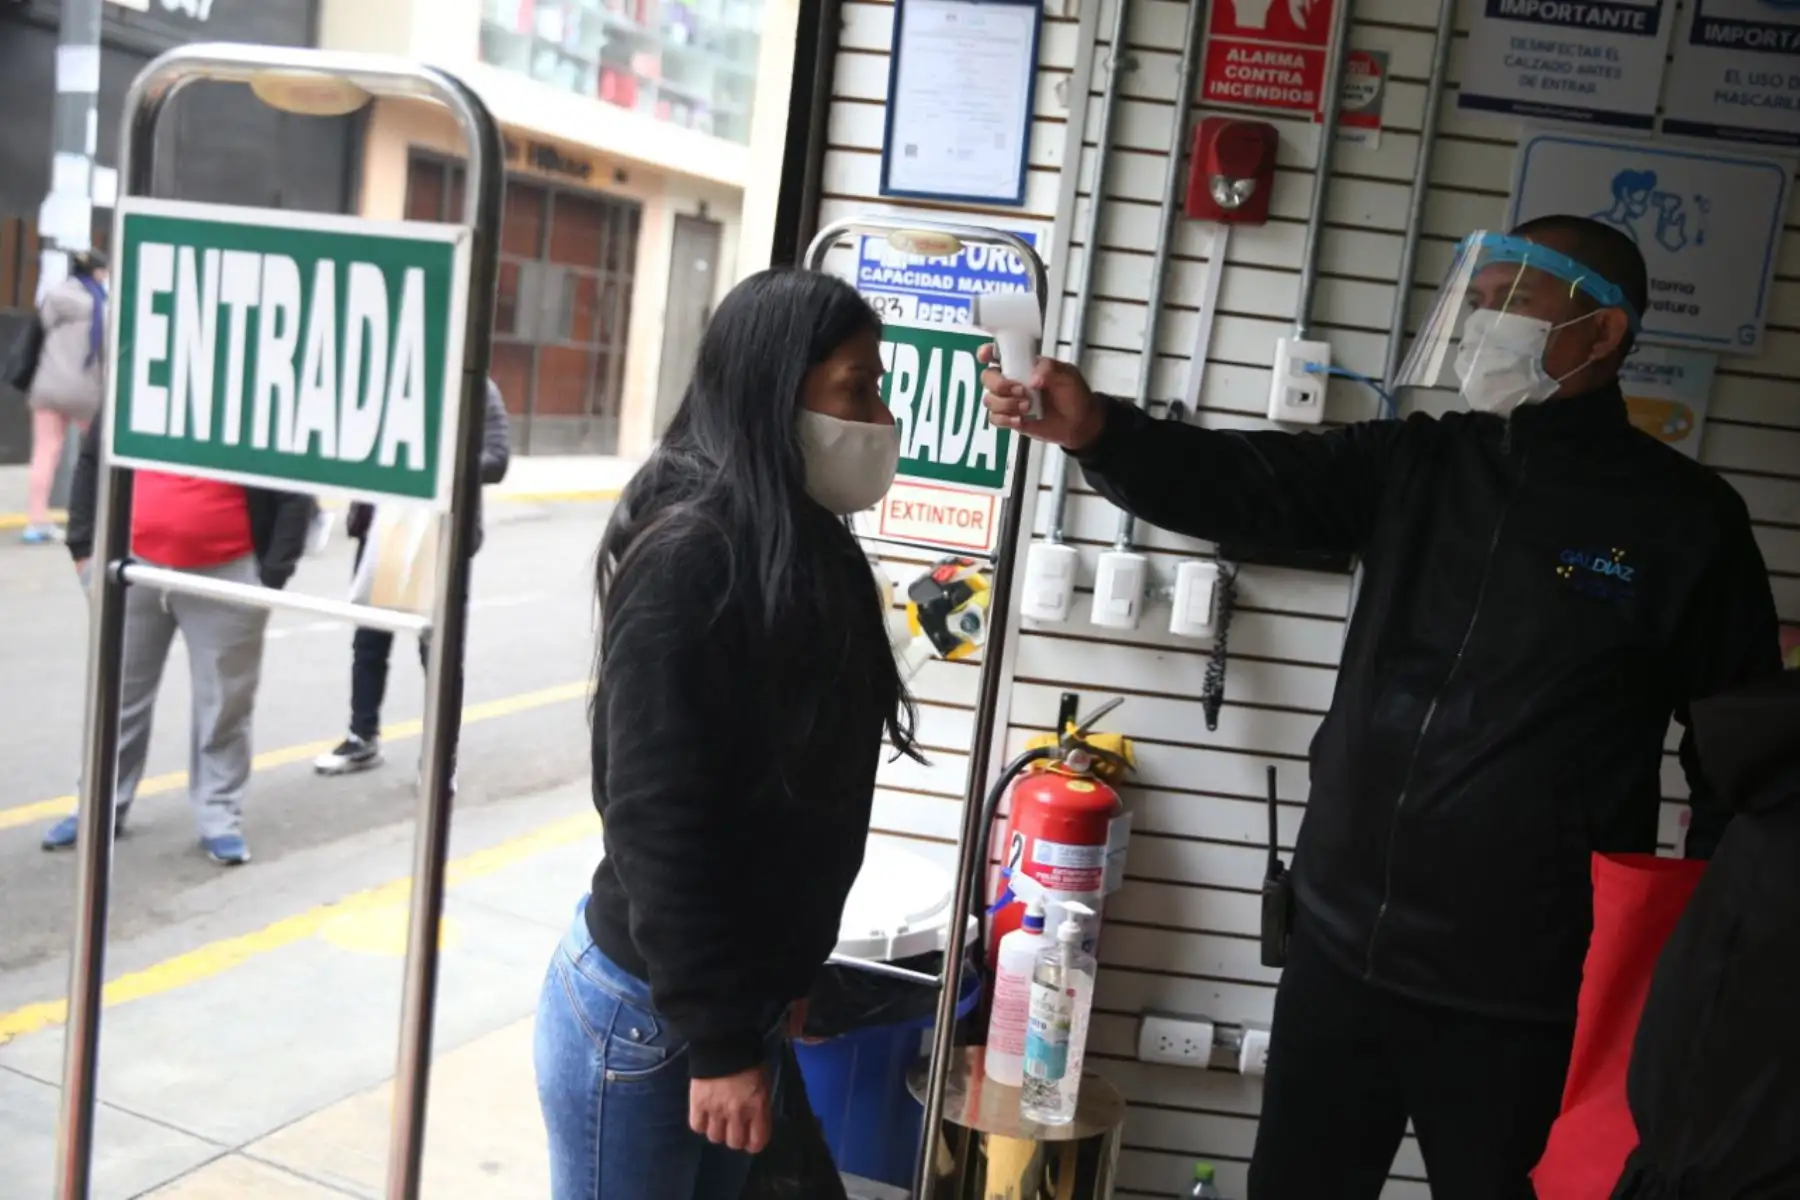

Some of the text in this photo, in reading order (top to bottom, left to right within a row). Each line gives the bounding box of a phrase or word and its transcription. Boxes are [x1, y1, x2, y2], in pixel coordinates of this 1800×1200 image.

[1499, 0, 1647, 30] IMPORTANTE
[1227, 48, 1306, 70] ALARMA
[1510, 36, 1620, 62] DESINFECTAR EL
[1224, 65, 1304, 86] CONTRA
[1503, 54, 1622, 80] CALZADO ANTES
[1724, 68, 1741, 85] EL
[1748, 71, 1784, 89] USO
[1209, 81, 1315, 105] INCENDIOS
[1518, 75, 1597, 95] DE ENTRAR
[860, 265, 1028, 294] CAPACIDAD MAXIMA
[1650, 277, 1696, 296] toma
[130, 240, 426, 472] ENTRADA
[890, 498, 985, 530] EXTINTOR
